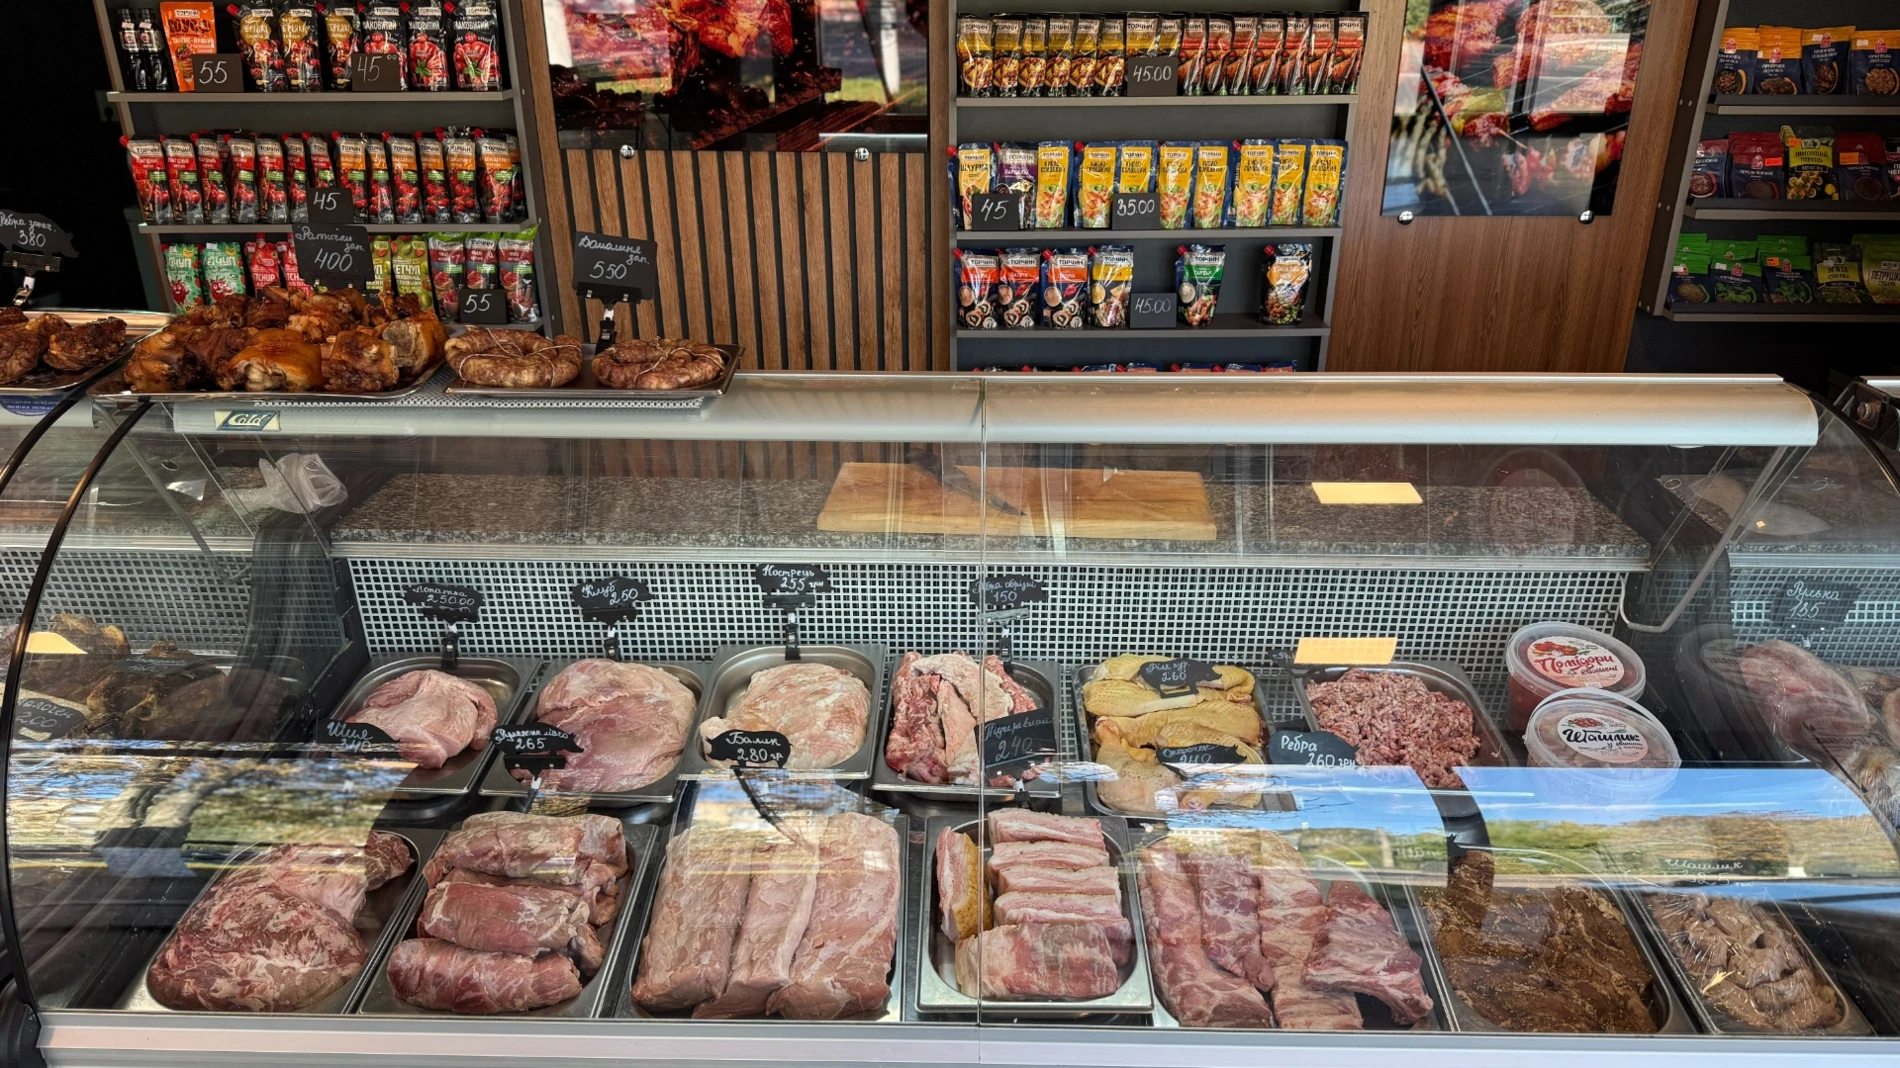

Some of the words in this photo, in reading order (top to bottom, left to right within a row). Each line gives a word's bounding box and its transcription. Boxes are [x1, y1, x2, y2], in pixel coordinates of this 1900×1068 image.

[199, 61, 227, 83] 55
[358, 56, 380, 81] 45
[1133, 66, 1172, 82] 45.00
[313, 192, 341, 211] 45
[1117, 199, 1155, 216] 35.00
[981, 199, 1009, 221] 45
[18, 230, 46, 247] 380
[314, 249, 352, 271] 400
[590, 261, 627, 279] 550
[464, 294, 492, 313] 55
[1135, 298, 1171, 314] 45.00
[762, 564, 815, 578] Кострець
[780, 577, 806, 590] 255
[1787, 581, 1840, 601] Рулька
[426, 595, 475, 605] 250.00
[610, 588, 638, 605] 250
[994, 590, 1017, 602] 150
[1534, 655, 1614, 674] Помідори
[1162, 672, 1186, 682] 260
[15, 712, 57, 727] 200
[515, 738, 546, 749] 265
[726, 732, 781, 746] Балик
[1281, 734, 1317, 753] Ребра
[1562, 729, 1640, 743] Шашлик
[341, 739, 371, 753] 340
[737, 748, 768, 761] 280
[1306, 753, 1335, 768] 260
[1665, 859, 1743, 870] Шашлик
